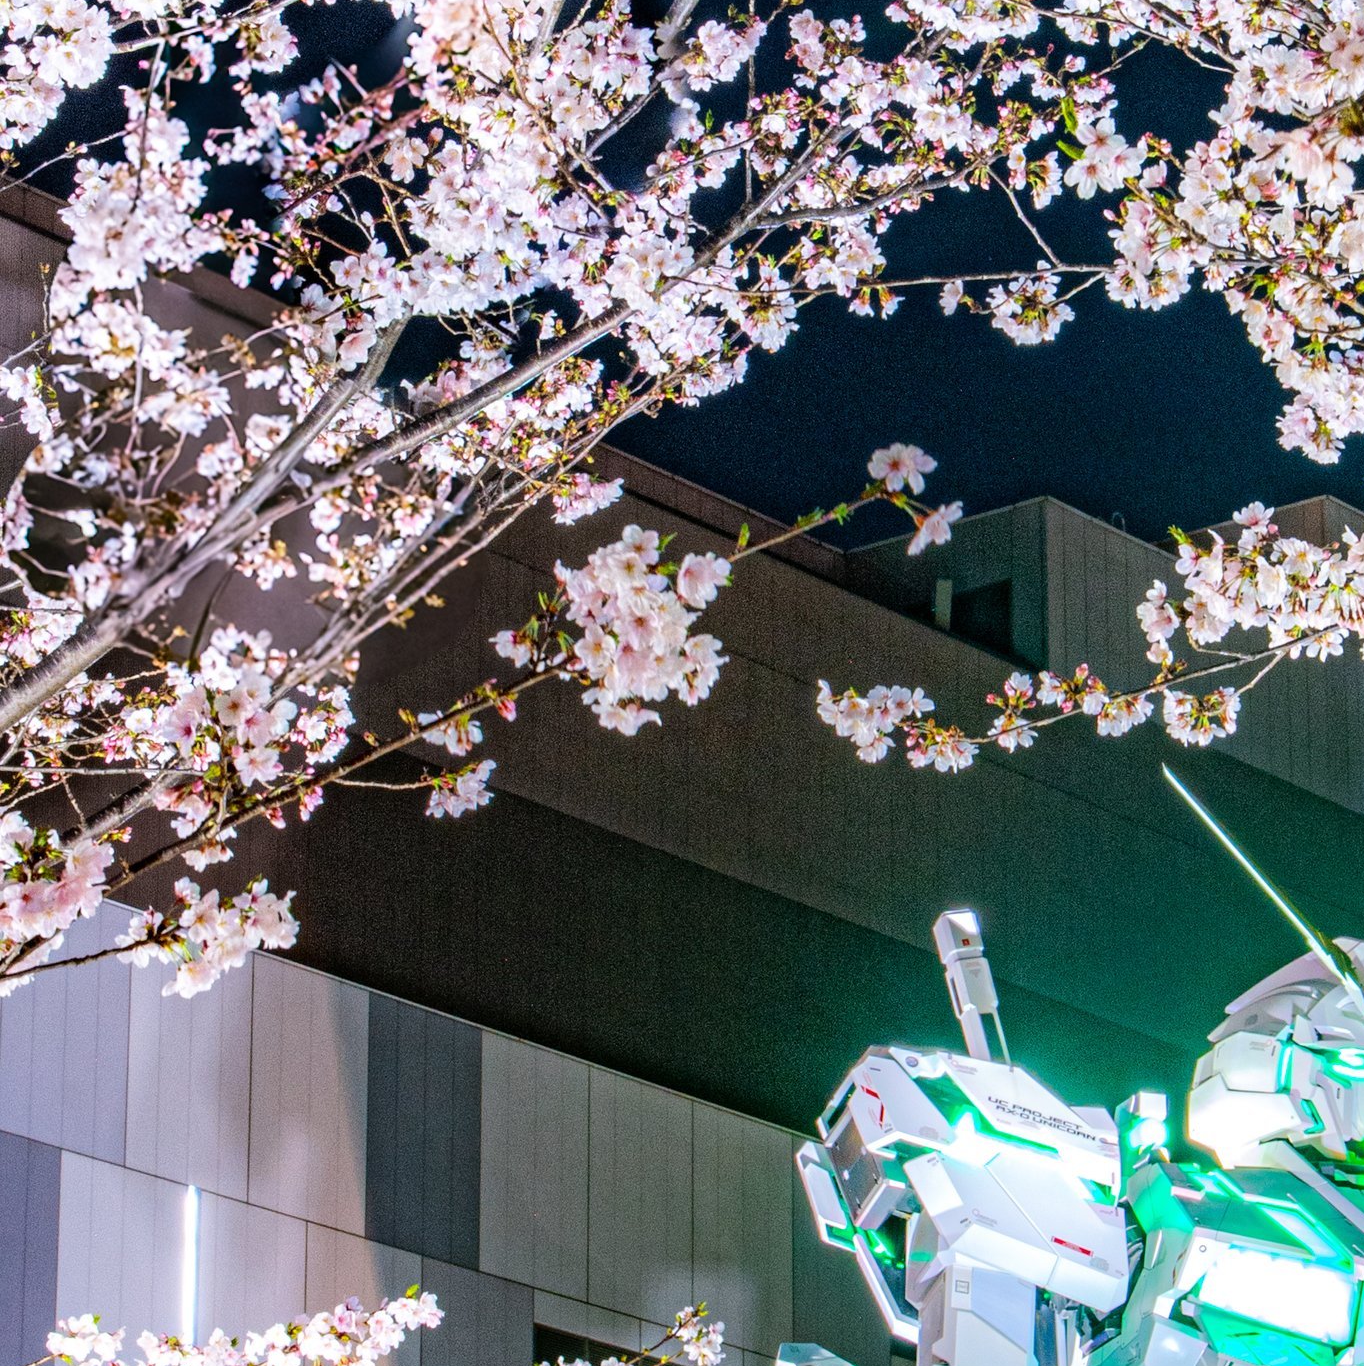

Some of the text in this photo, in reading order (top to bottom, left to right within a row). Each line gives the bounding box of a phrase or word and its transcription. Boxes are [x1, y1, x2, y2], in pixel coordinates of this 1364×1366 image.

[988, 1096, 1009, 1107] UC
[1012, 1104, 1083, 1130] PROJECT
[1032, 1117, 1096, 1141] UNICORN
